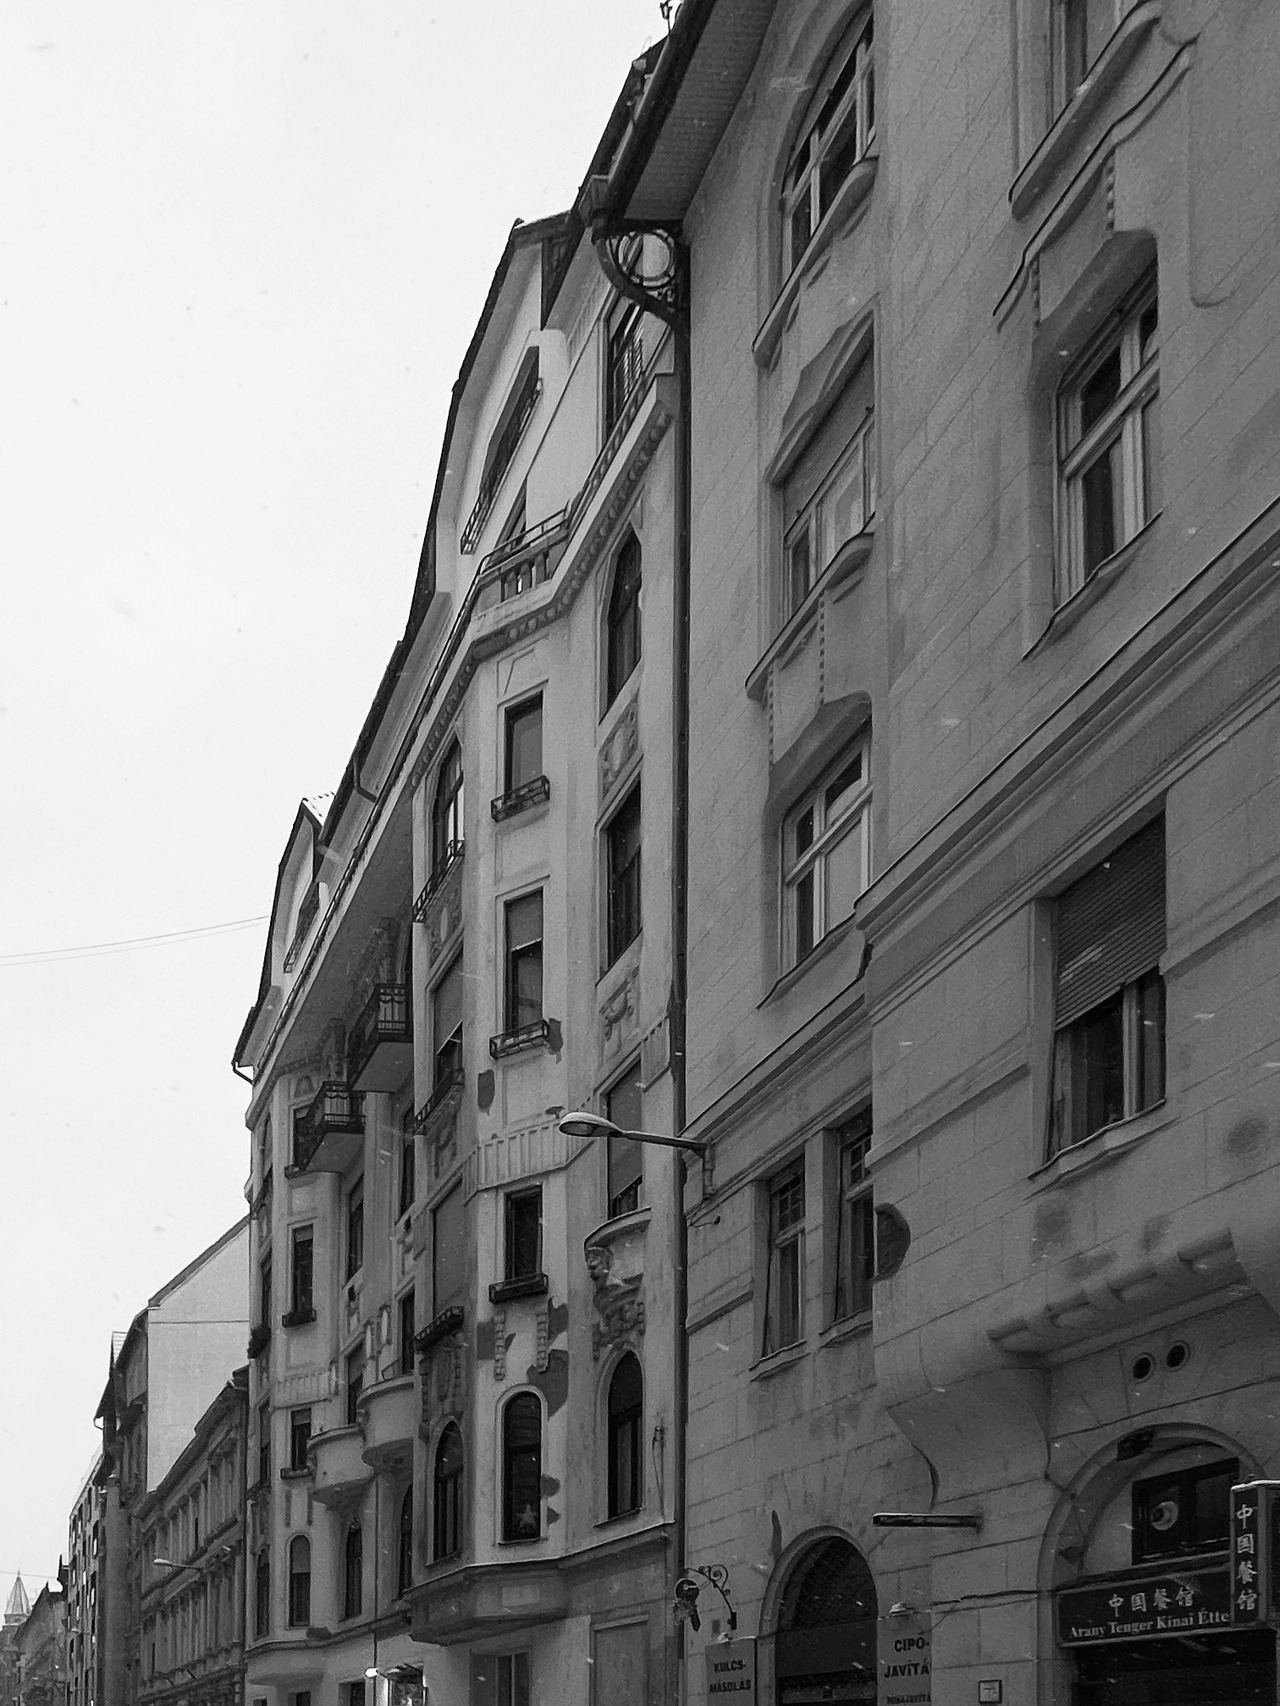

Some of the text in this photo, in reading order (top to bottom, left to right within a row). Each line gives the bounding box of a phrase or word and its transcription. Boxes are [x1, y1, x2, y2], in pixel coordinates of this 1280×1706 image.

[1071, 1625, 1105, 1638] Arany
[1108, 1620, 1153, 1634] Tenger
[1198, 1607, 1230, 1625] Étte
[884, 1658, 930, 1678] JAVÍTÁ
